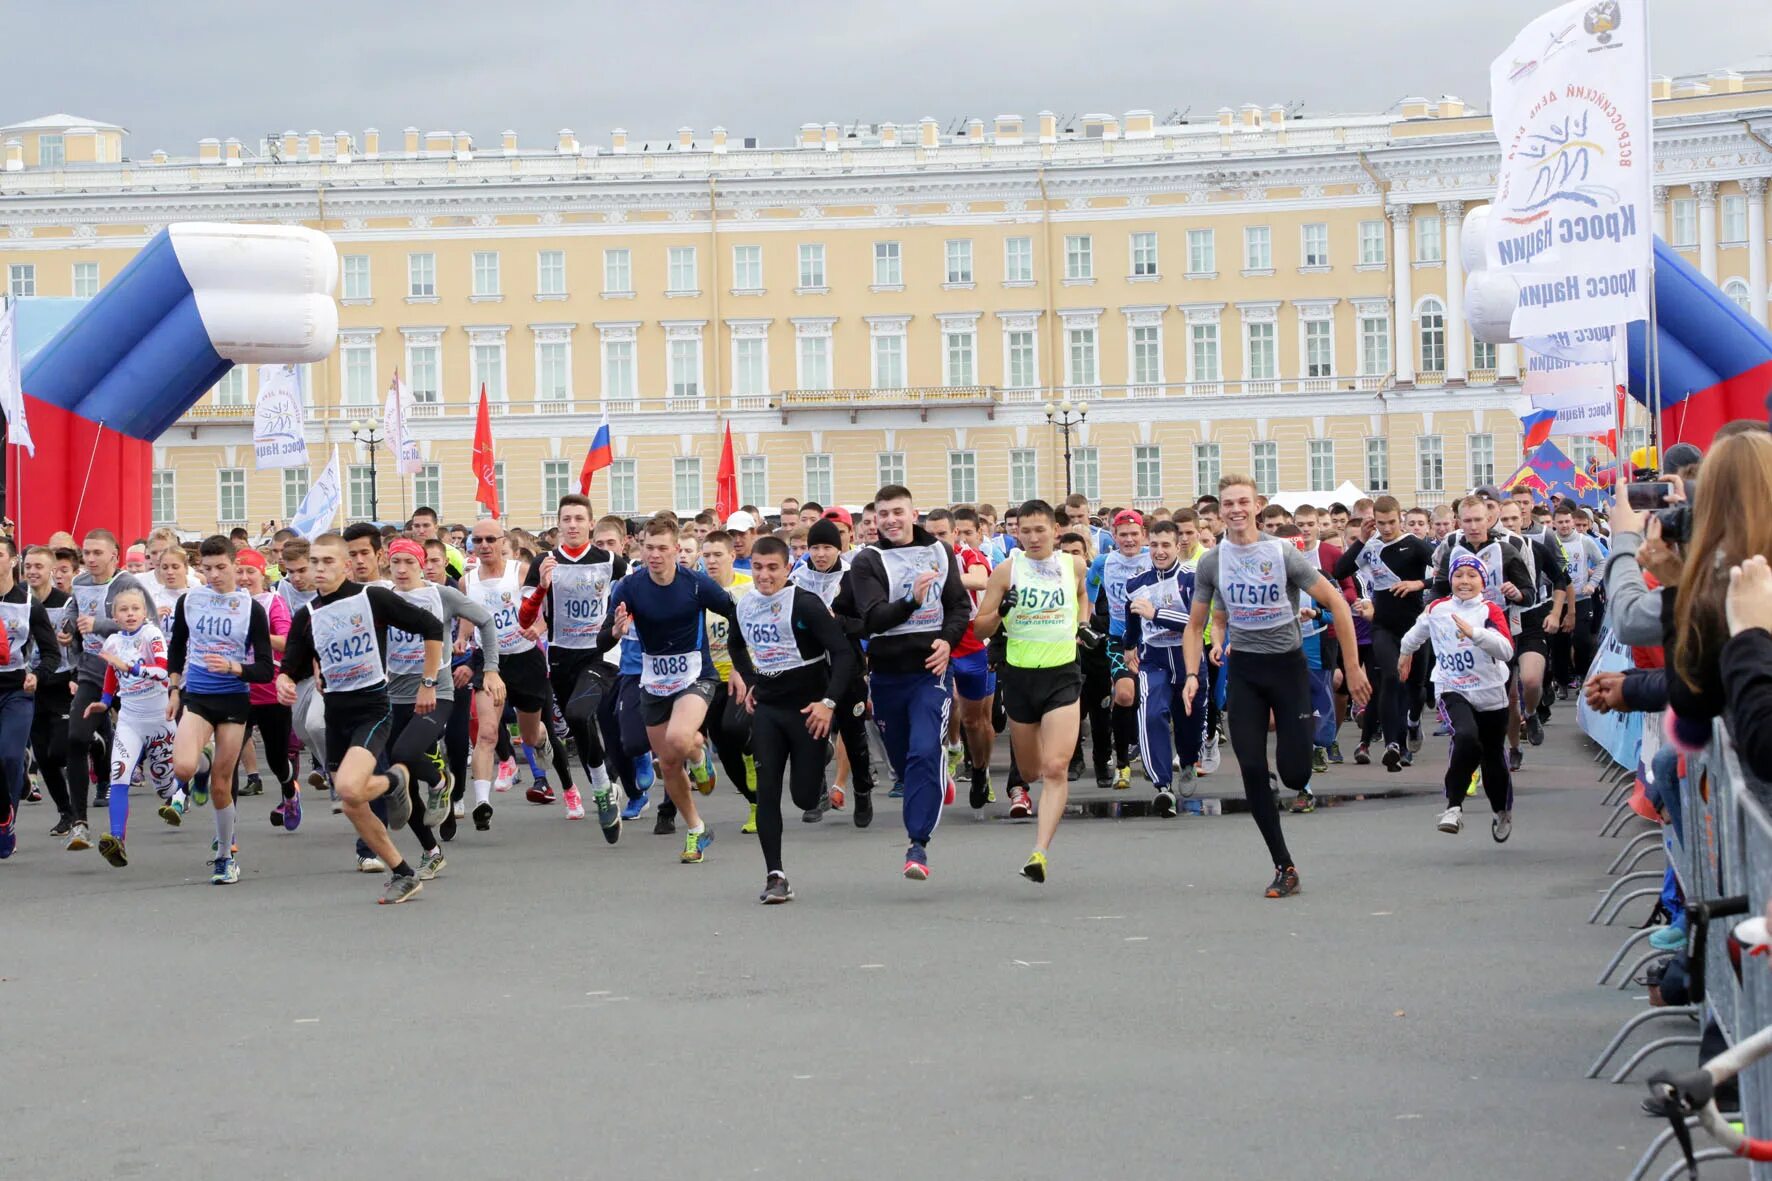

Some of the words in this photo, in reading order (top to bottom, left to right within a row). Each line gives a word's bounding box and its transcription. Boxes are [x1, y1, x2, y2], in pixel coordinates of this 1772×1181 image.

[1110, 582, 1124, 600] 17
[1227, 583, 1280, 605] 17576
[564, 598, 603, 618] 19021
[196, 615, 232, 636] 4110
[711, 622, 729, 638] 15
[746, 622, 780, 643] 7853
[324, 632, 374, 664] 15422
[653, 655, 688, 676] 8088
